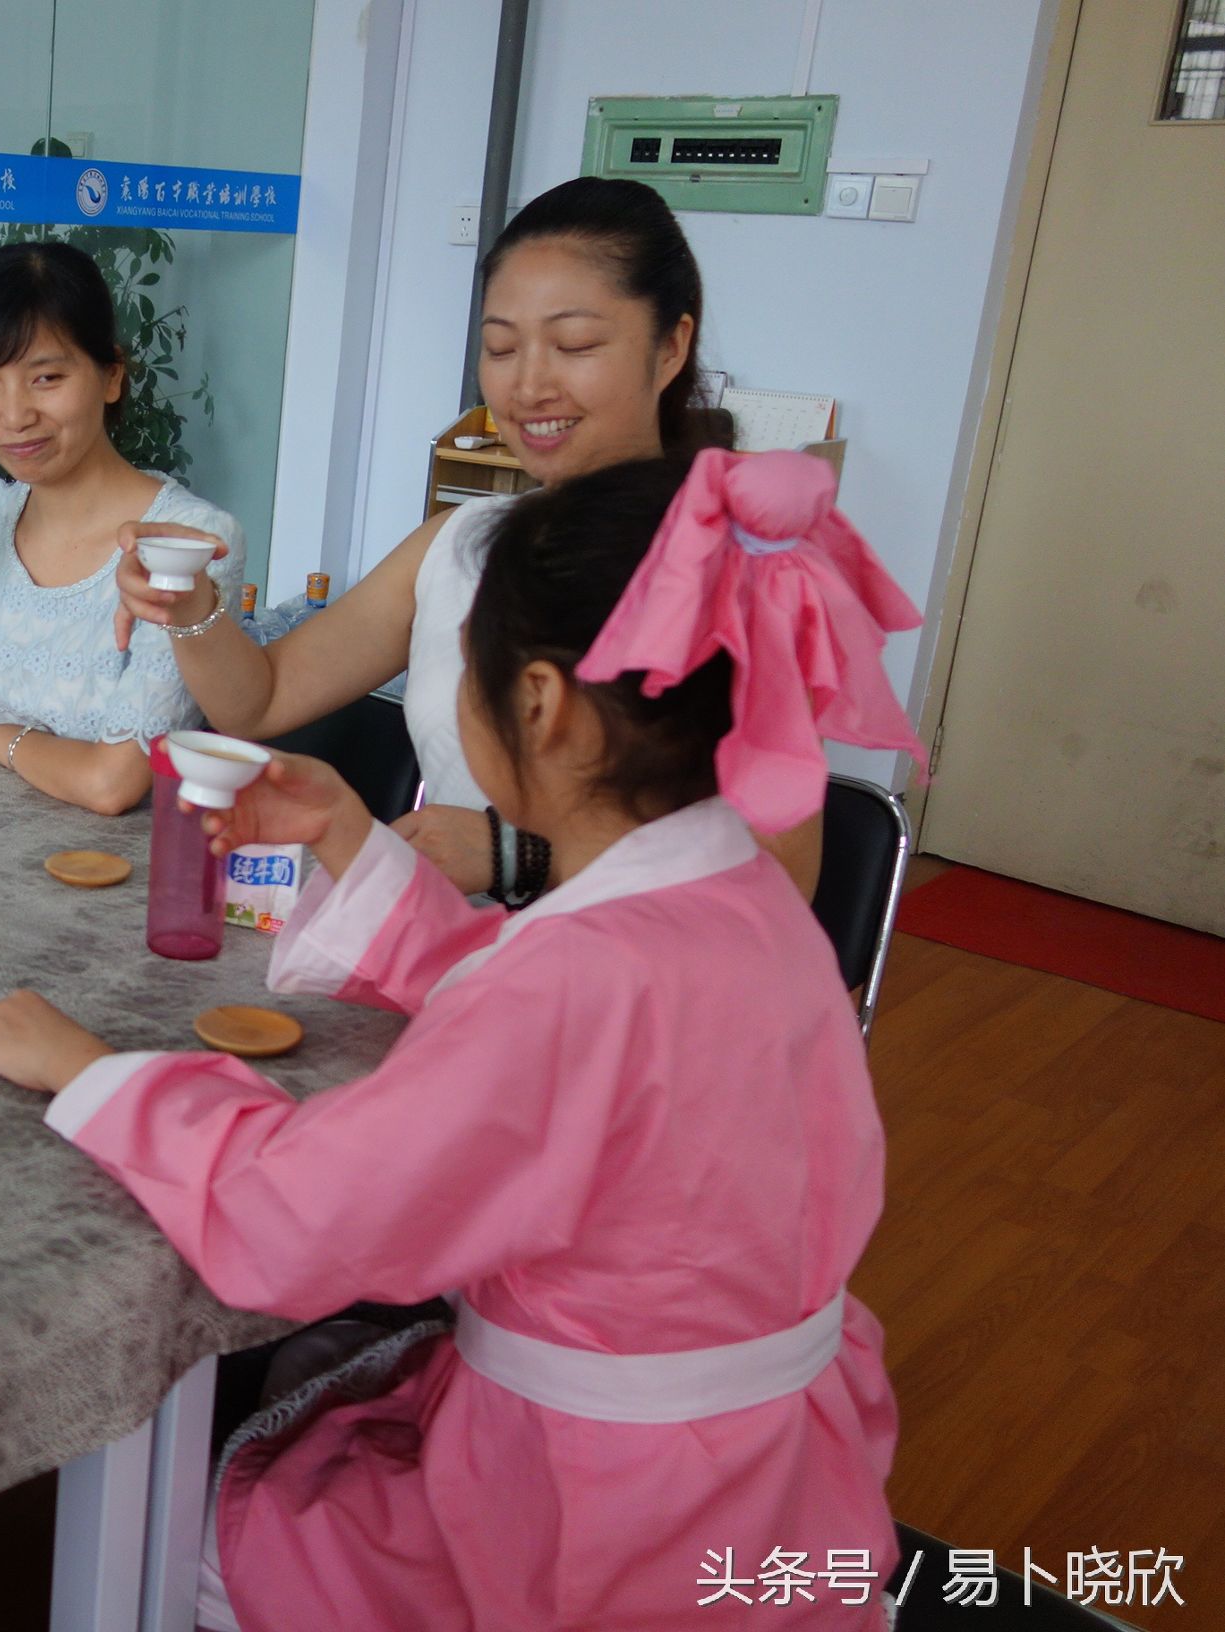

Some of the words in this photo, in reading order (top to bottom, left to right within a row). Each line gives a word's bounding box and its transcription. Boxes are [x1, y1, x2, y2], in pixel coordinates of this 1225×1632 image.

[116, 205, 157, 217] XIANGYANG
[157, 208, 179, 218] BAICAI
[180, 209, 220, 220] VOCATIONAL
[221, 211, 250, 222] TRAINING
[251, 212, 275, 223] SCHOOL
[232, 856, 291, 885] 纯牛奶
